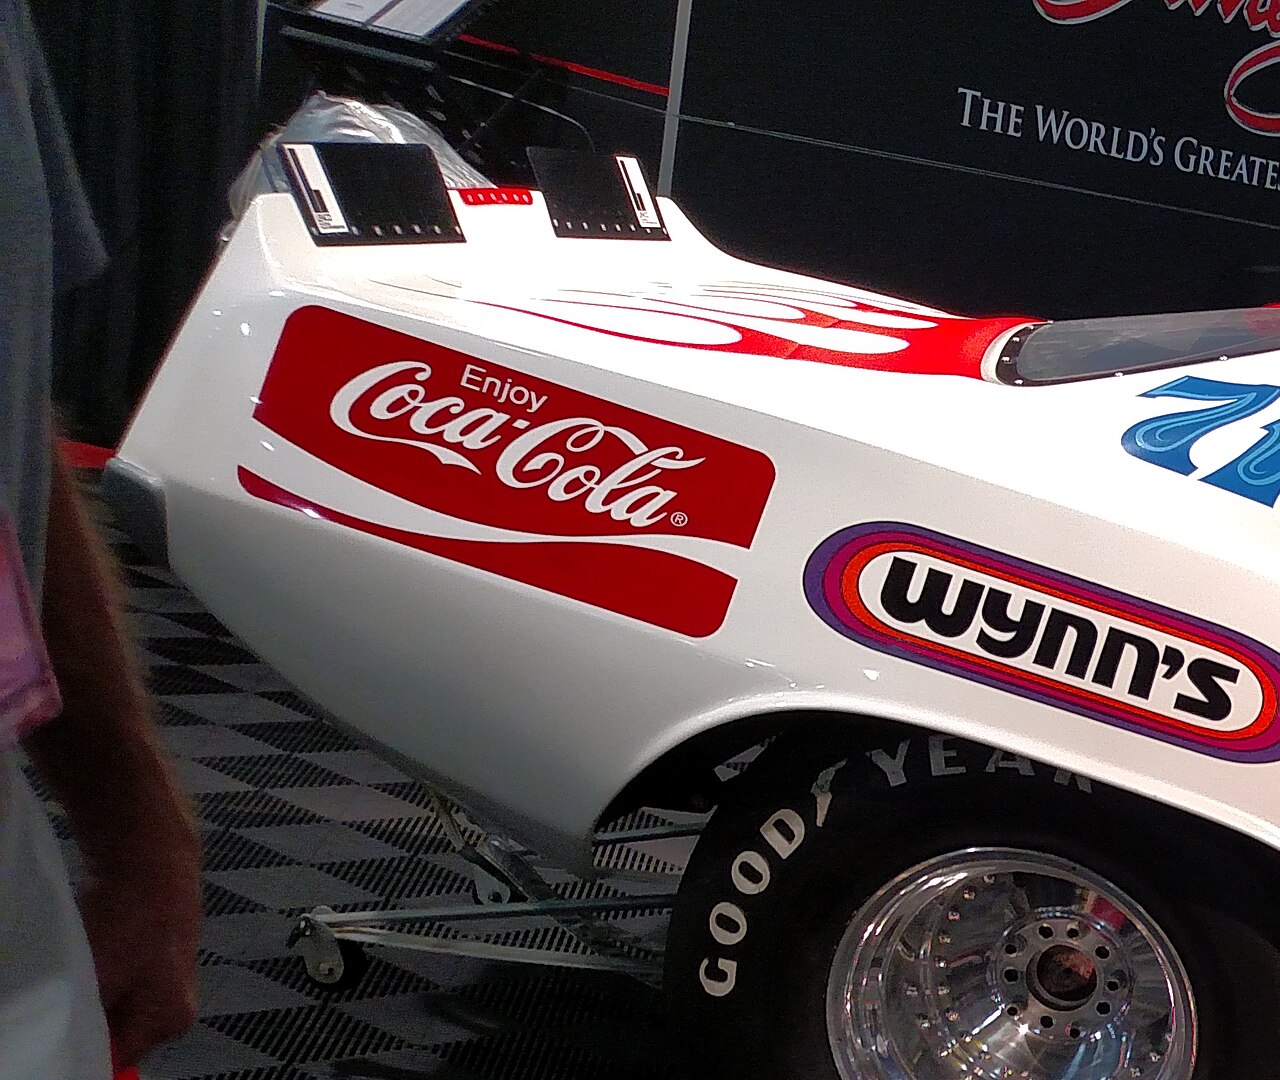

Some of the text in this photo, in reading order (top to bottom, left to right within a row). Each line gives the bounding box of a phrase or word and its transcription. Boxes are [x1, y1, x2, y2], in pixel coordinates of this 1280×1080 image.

[958, 87, 1025, 138] THE
[1035, 104, 1166, 166] WORLD'S
[460, 363, 548, 413] Enjoy
[329, 360, 706, 528] Coca-Cola
